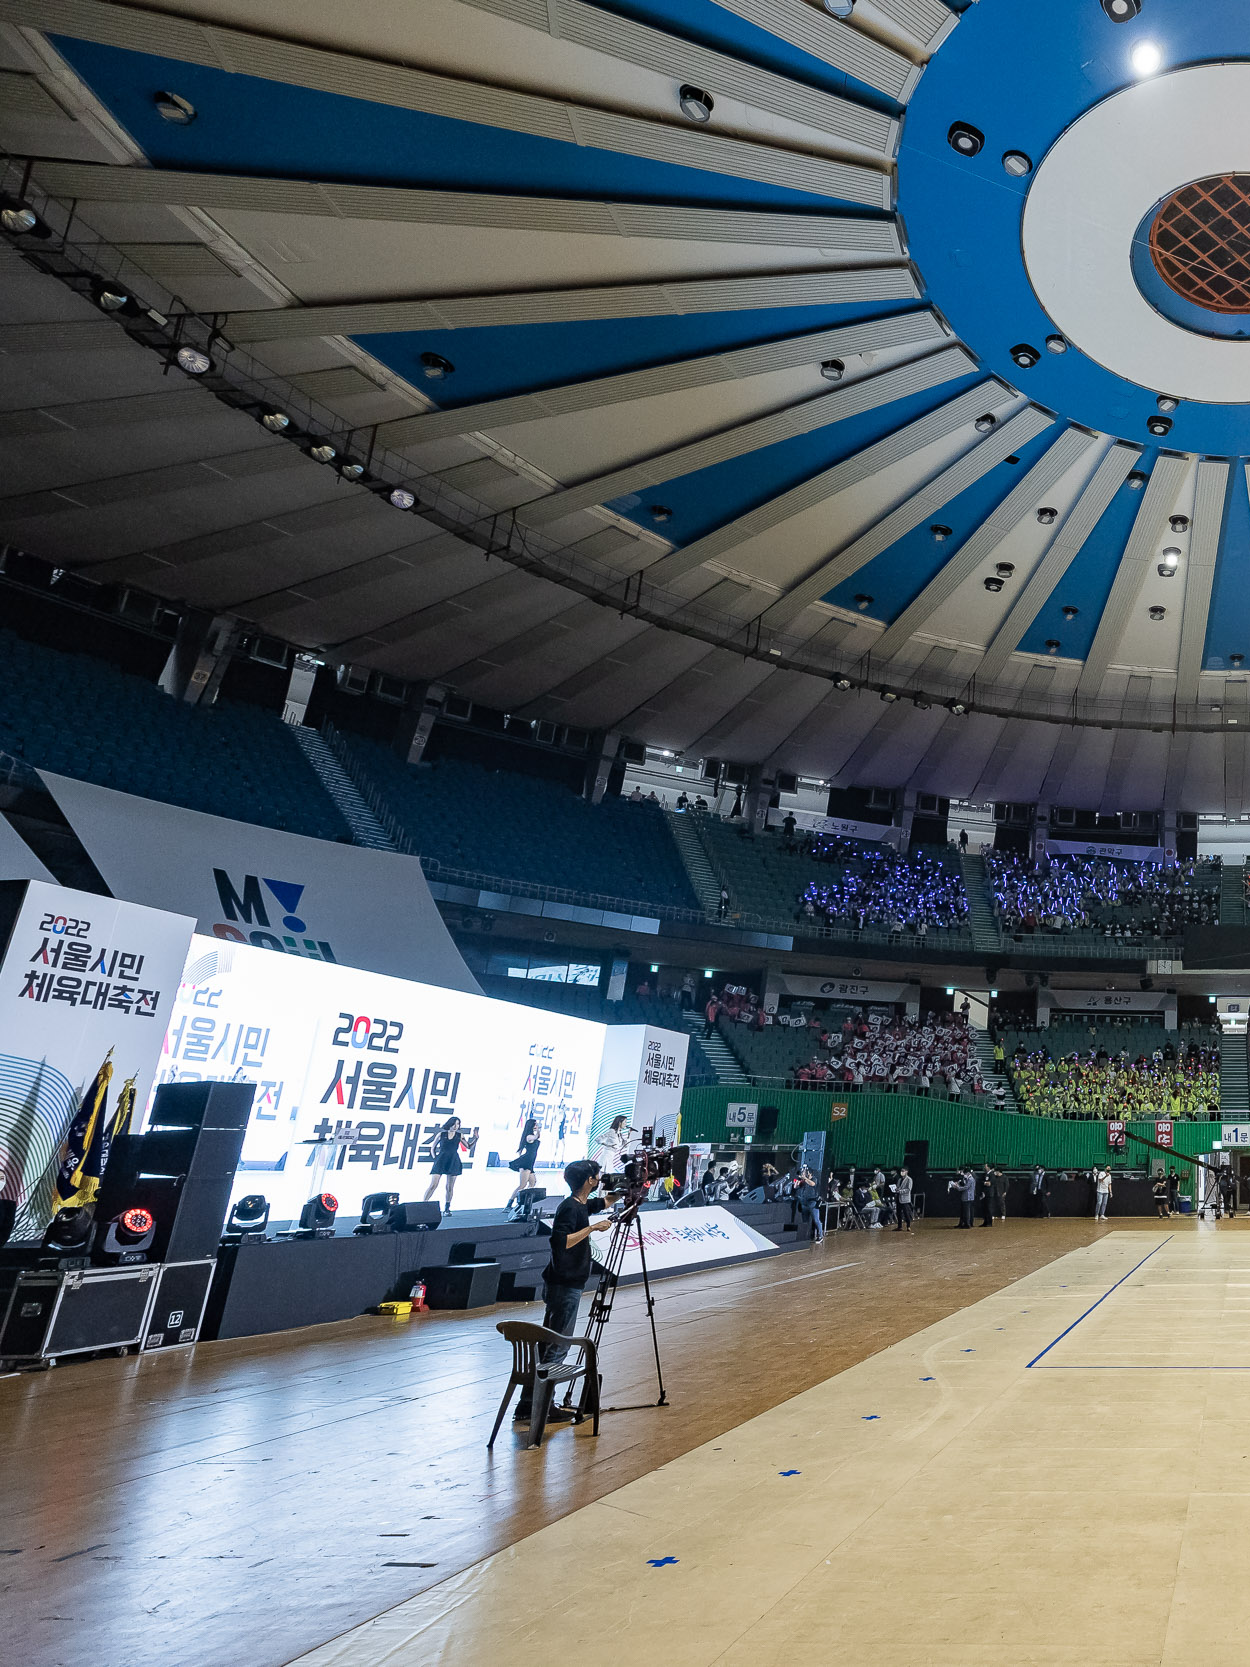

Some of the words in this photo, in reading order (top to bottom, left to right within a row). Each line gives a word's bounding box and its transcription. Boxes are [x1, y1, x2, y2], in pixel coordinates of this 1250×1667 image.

[830, 823, 858, 833] 노원구
[39, 912, 91, 938] 2022
[30, 937, 144, 982] 서울시민
[18, 969, 161, 1018] 체육대축전
[838, 983, 869, 995] 광진구
[1103, 996, 1131, 1005] 용산구
[332, 1012, 404, 1054] 2022
[645, 1052, 676, 1071] 서울시민
[319, 1059, 461, 1115] 서울시민
[523, 1064, 577, 1099] 서울시민
[643, 1069, 681, 1089] 체육대축전
[832, 1106, 847, 1117] S2
[169, 1314, 182, 1325] 12
